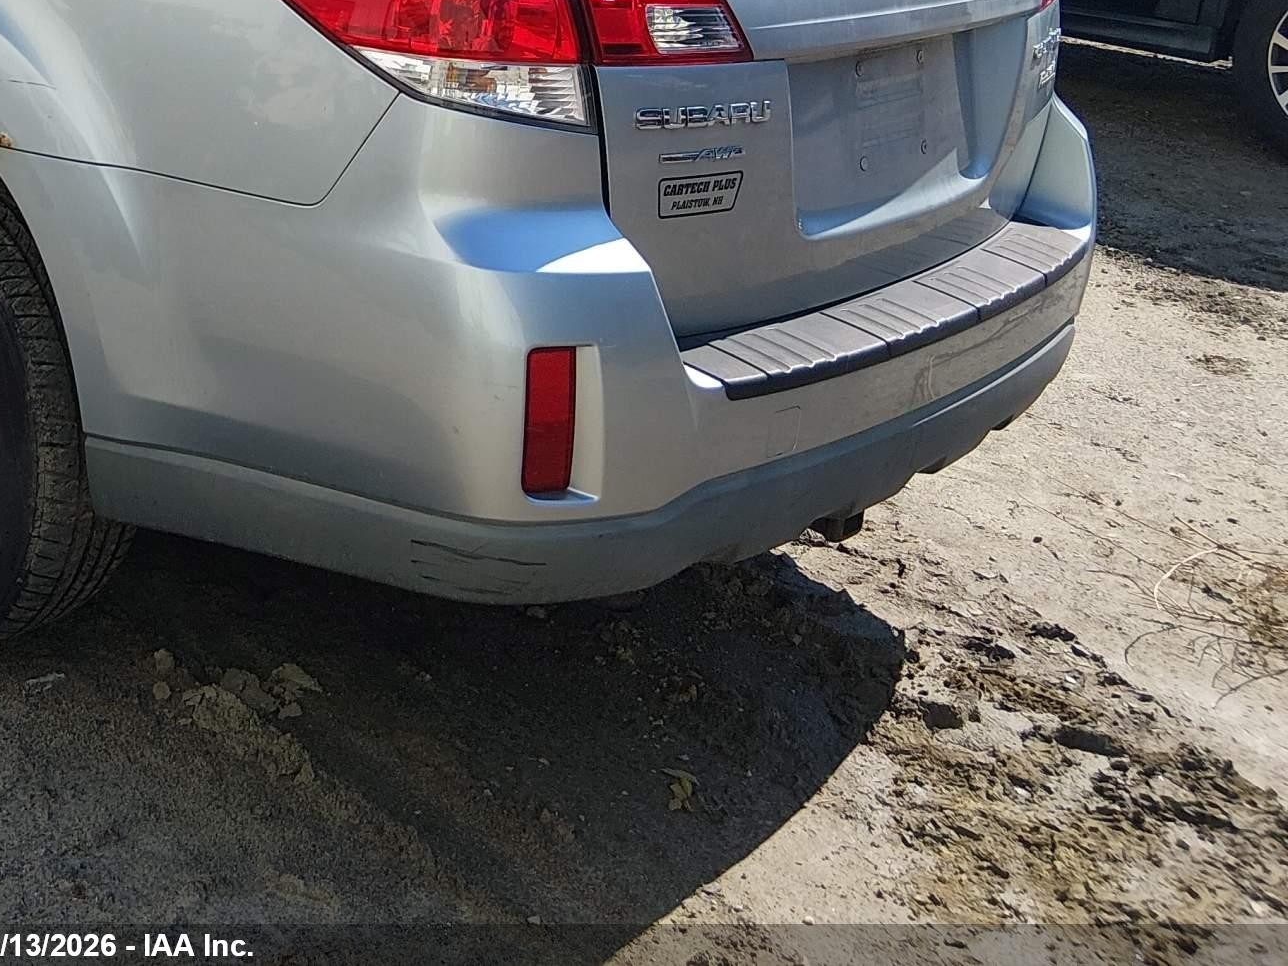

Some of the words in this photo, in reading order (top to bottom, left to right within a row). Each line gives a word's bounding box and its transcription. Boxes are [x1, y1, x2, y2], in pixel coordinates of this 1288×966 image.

[635, 99, 772, 130] SUBARU
[663, 181, 711, 197] CARTECH
[711, 177, 738, 192] PLUS
[712, 195, 724, 206] NH
